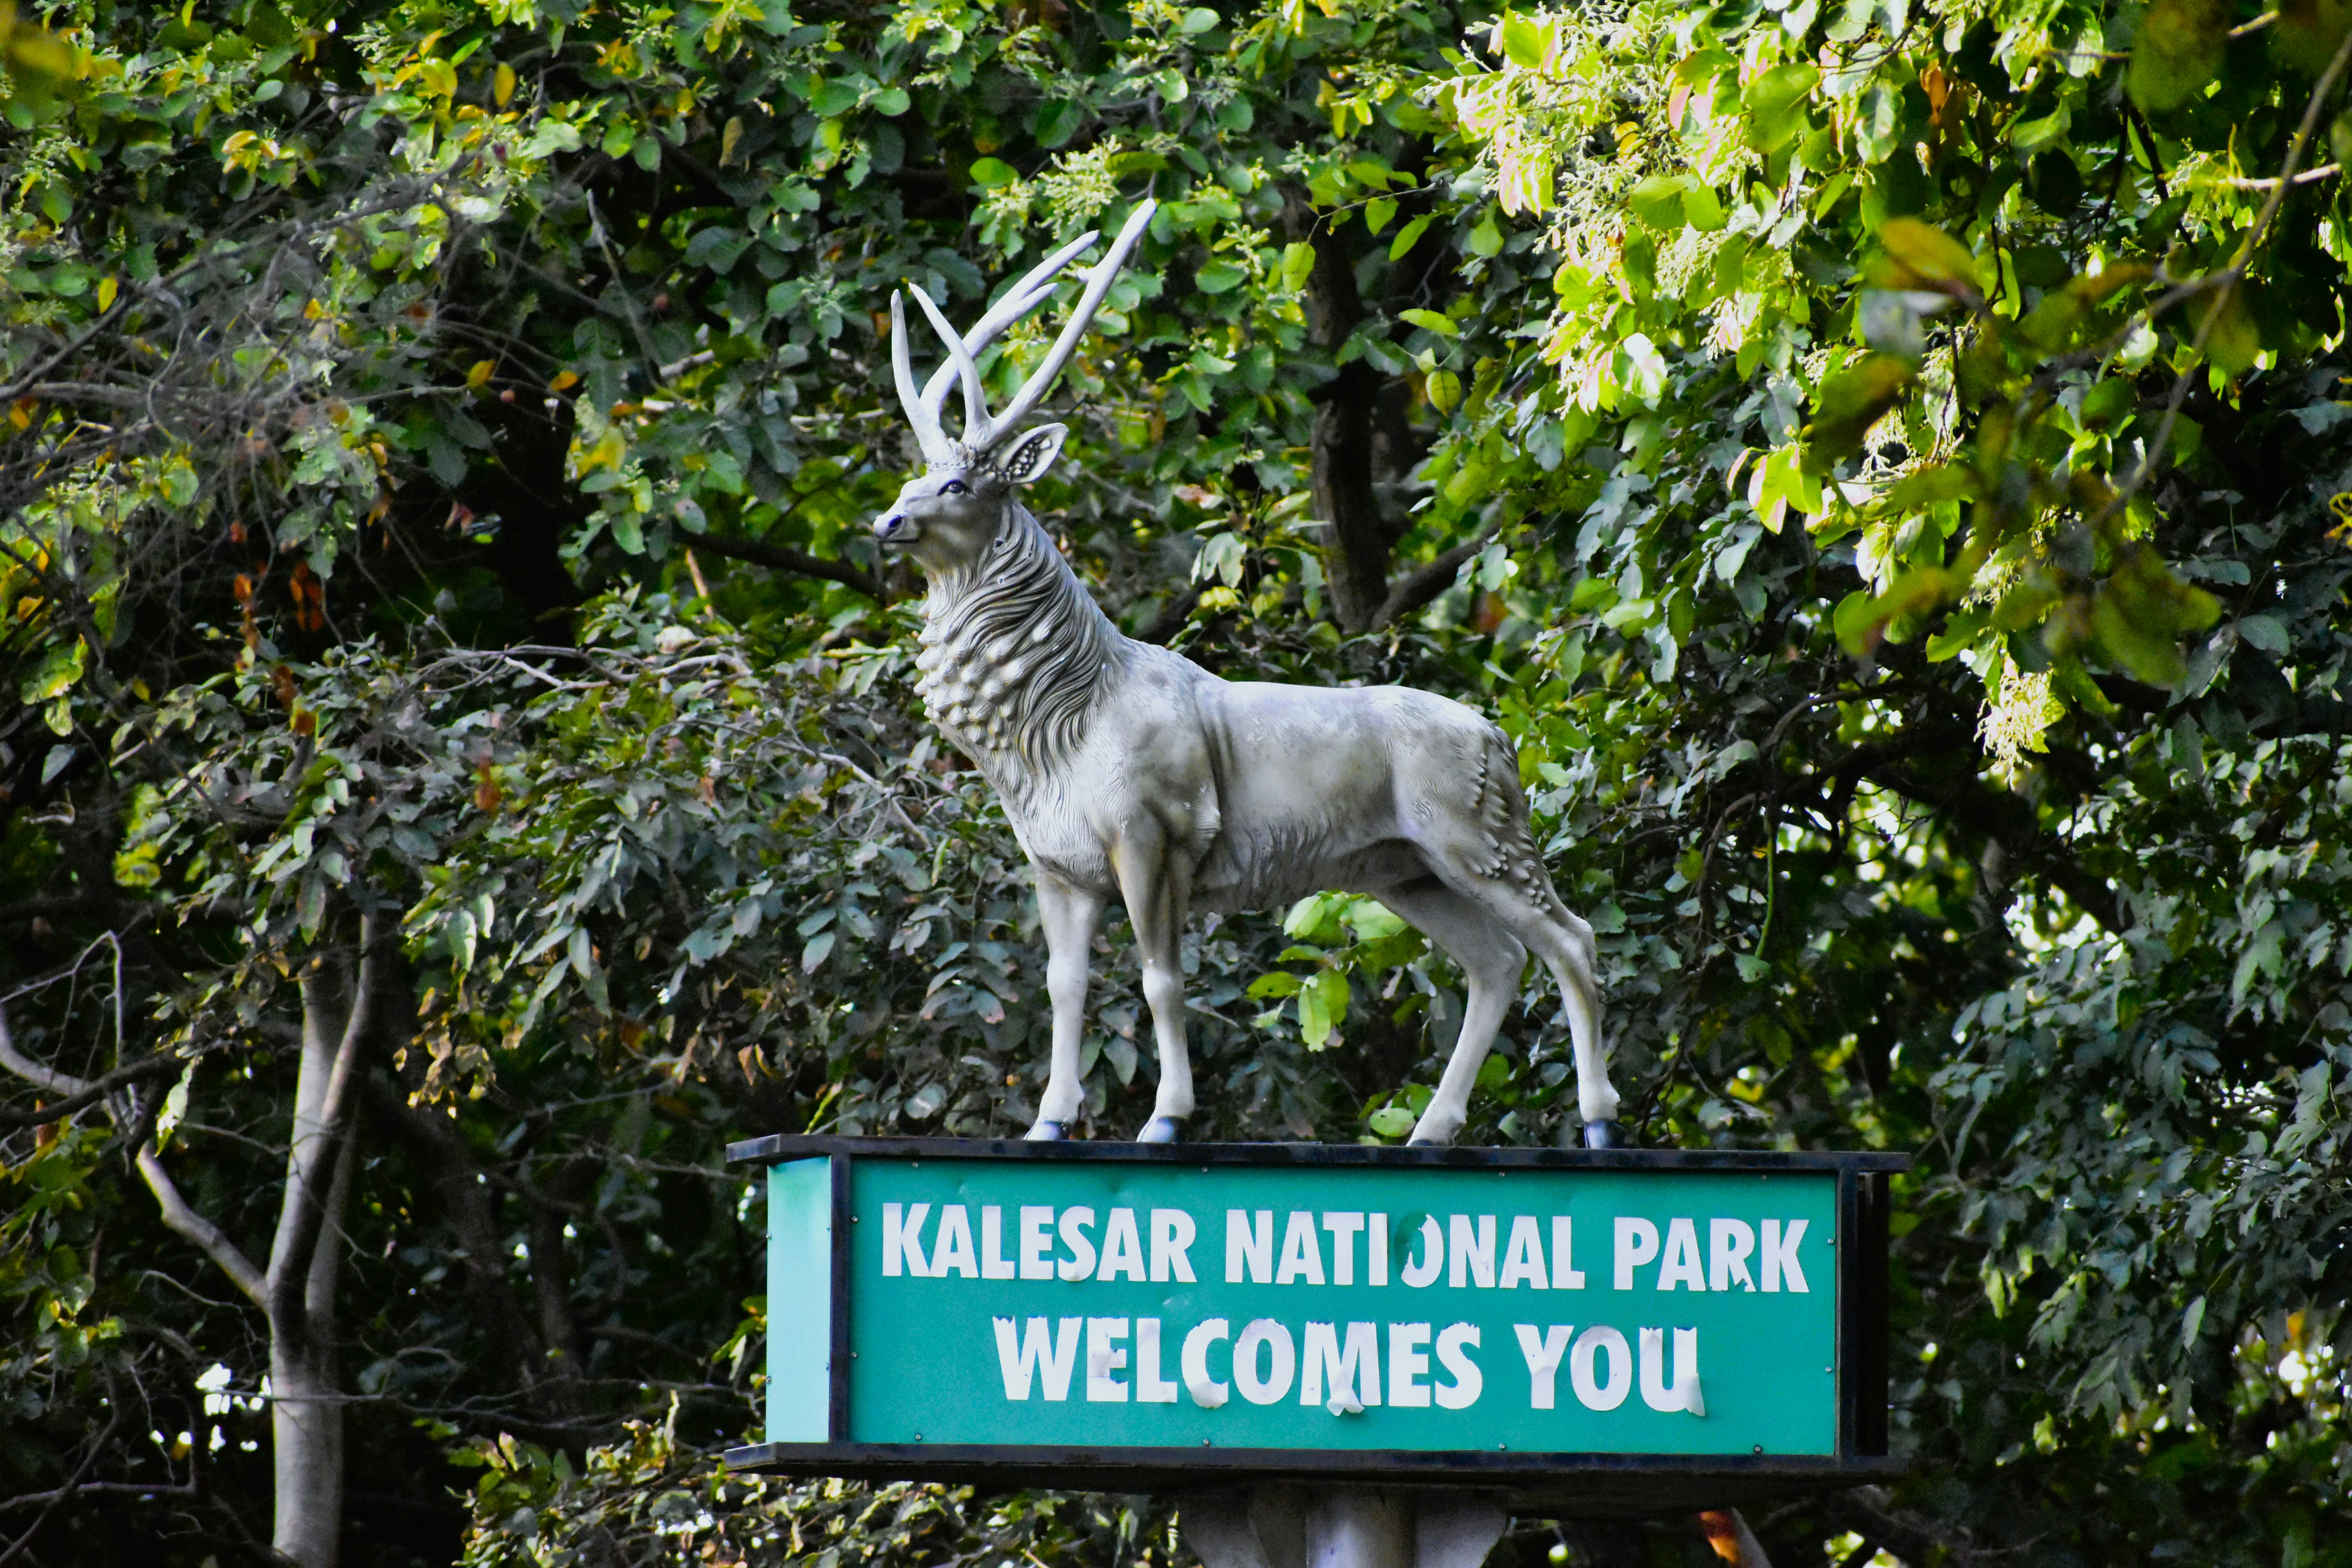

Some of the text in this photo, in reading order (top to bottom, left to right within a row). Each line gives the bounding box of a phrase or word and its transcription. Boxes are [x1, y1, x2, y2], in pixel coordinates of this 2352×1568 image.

[882, 1203, 1809, 1293] KALESAR NATIONAL PARK
[992, 1316, 1706, 1417] WELCOMES YOU
